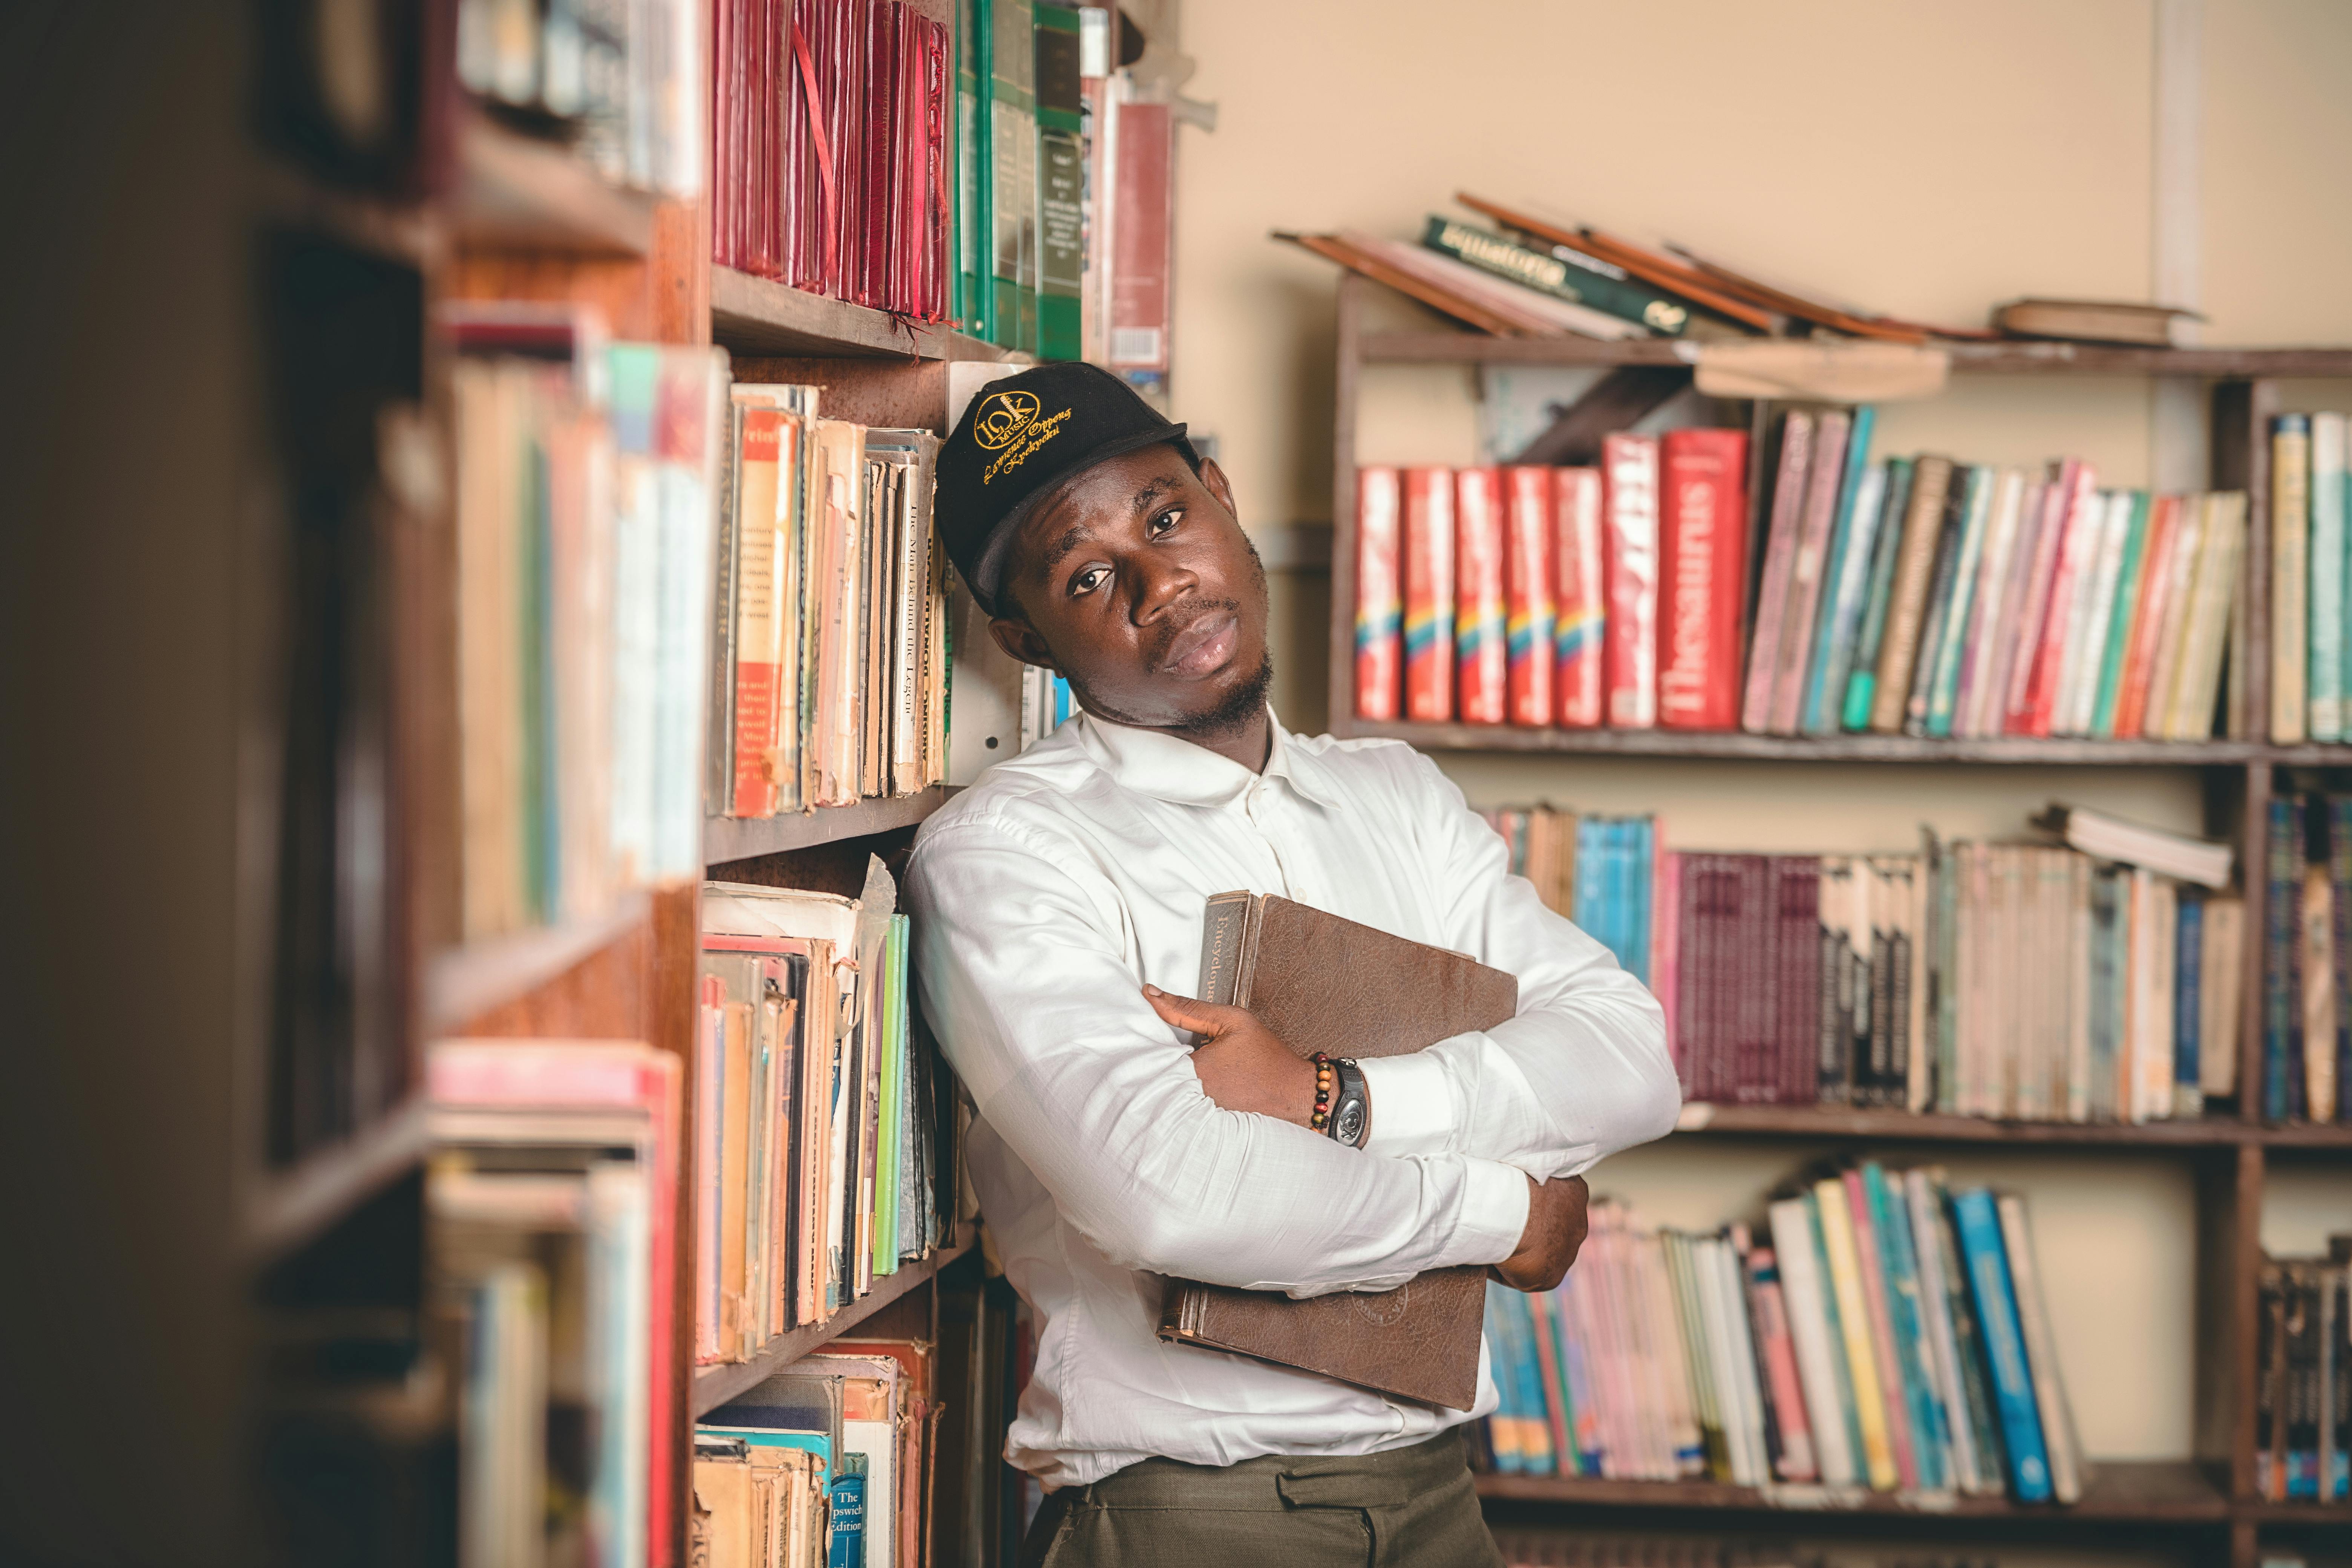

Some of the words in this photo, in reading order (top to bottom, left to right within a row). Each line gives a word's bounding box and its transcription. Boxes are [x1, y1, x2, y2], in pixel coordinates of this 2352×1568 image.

[998, 416, 1029, 444] MUSIC
[1028, 407, 1072, 436] Oppong
[907, 579, 916, 631] Behind
[906, 637, 915, 660] the
[944, 652, 952, 723] Updike
[1206, 916, 1228, 1003] Encyclopæ
[838, 1492, 859, 1503] The
[833, 1504, 862, 1520] pswich
[830, 1521, 861, 1532] Edition
